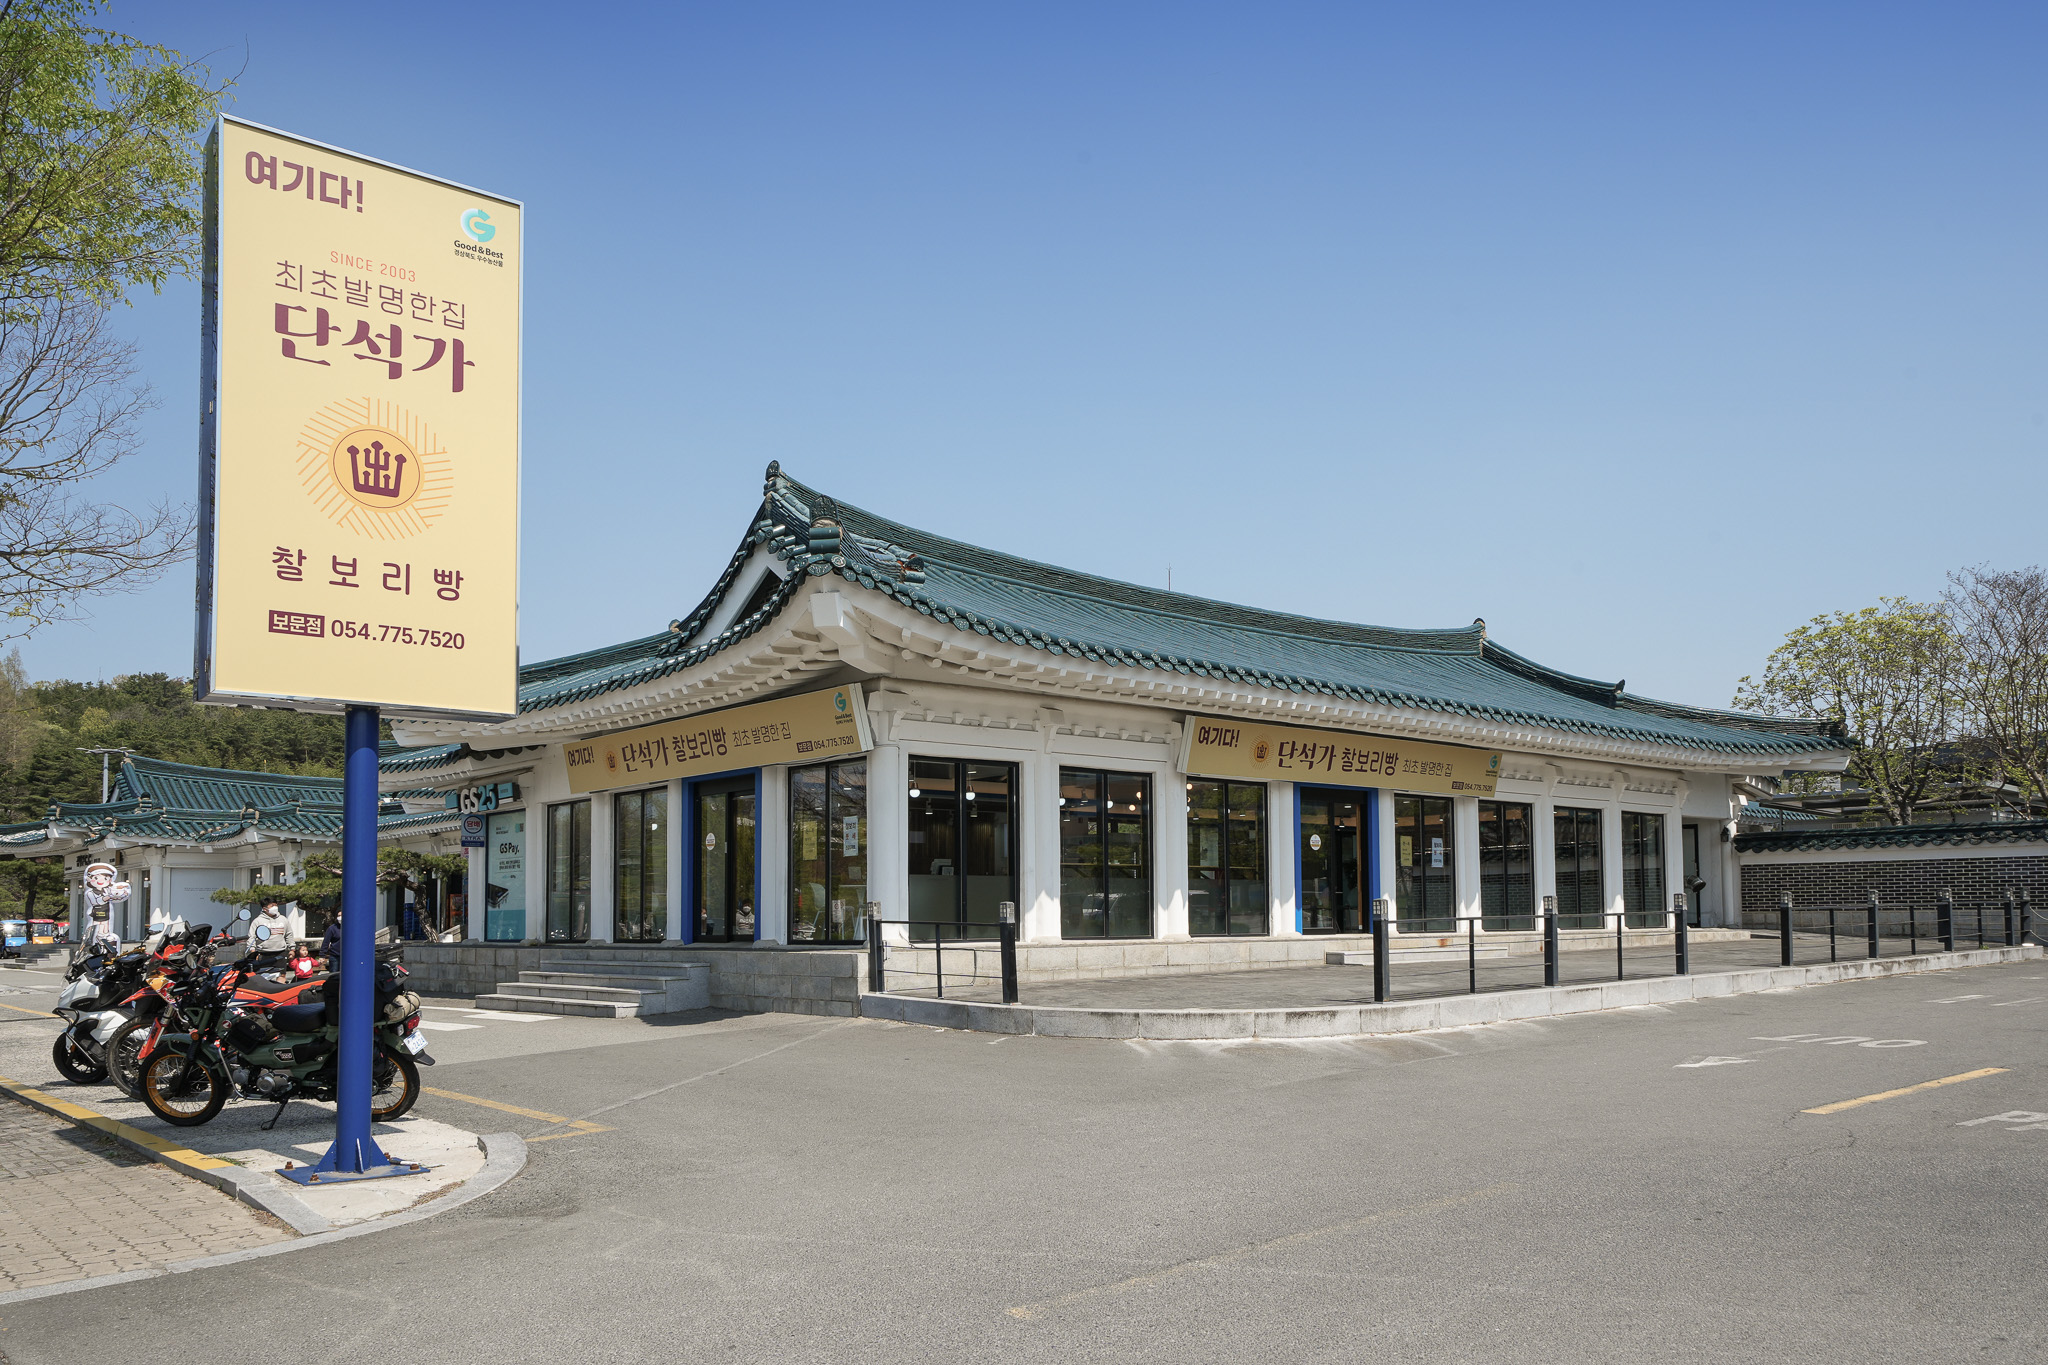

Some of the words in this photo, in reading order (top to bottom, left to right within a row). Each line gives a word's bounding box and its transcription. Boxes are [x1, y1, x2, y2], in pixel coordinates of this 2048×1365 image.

[245, 151, 364, 213] 여기다!
[330, 251, 373, 272] SINCE
[380, 263, 416, 283] 2003
[454, 249, 476, 260] 경상북도
[274, 303, 475, 393] 단석가
[272, 613, 321, 635] 보문점
[331, 619, 465, 650] 054.775.7520
[568, 746, 595, 767] 여기다!
[621, 737, 669, 772] 단석가
[672, 726, 728, 763] 찰보리빵
[814, 736, 854, 749] 054.775.7520
[1198, 726, 1240, 748] 여기다!
[1278, 741, 1337, 772] 단석가
[1341, 747, 1399, 776] 찰보리빵
[461, 783, 496, 815] GS25
[467, 820, 481, 828] 담배
